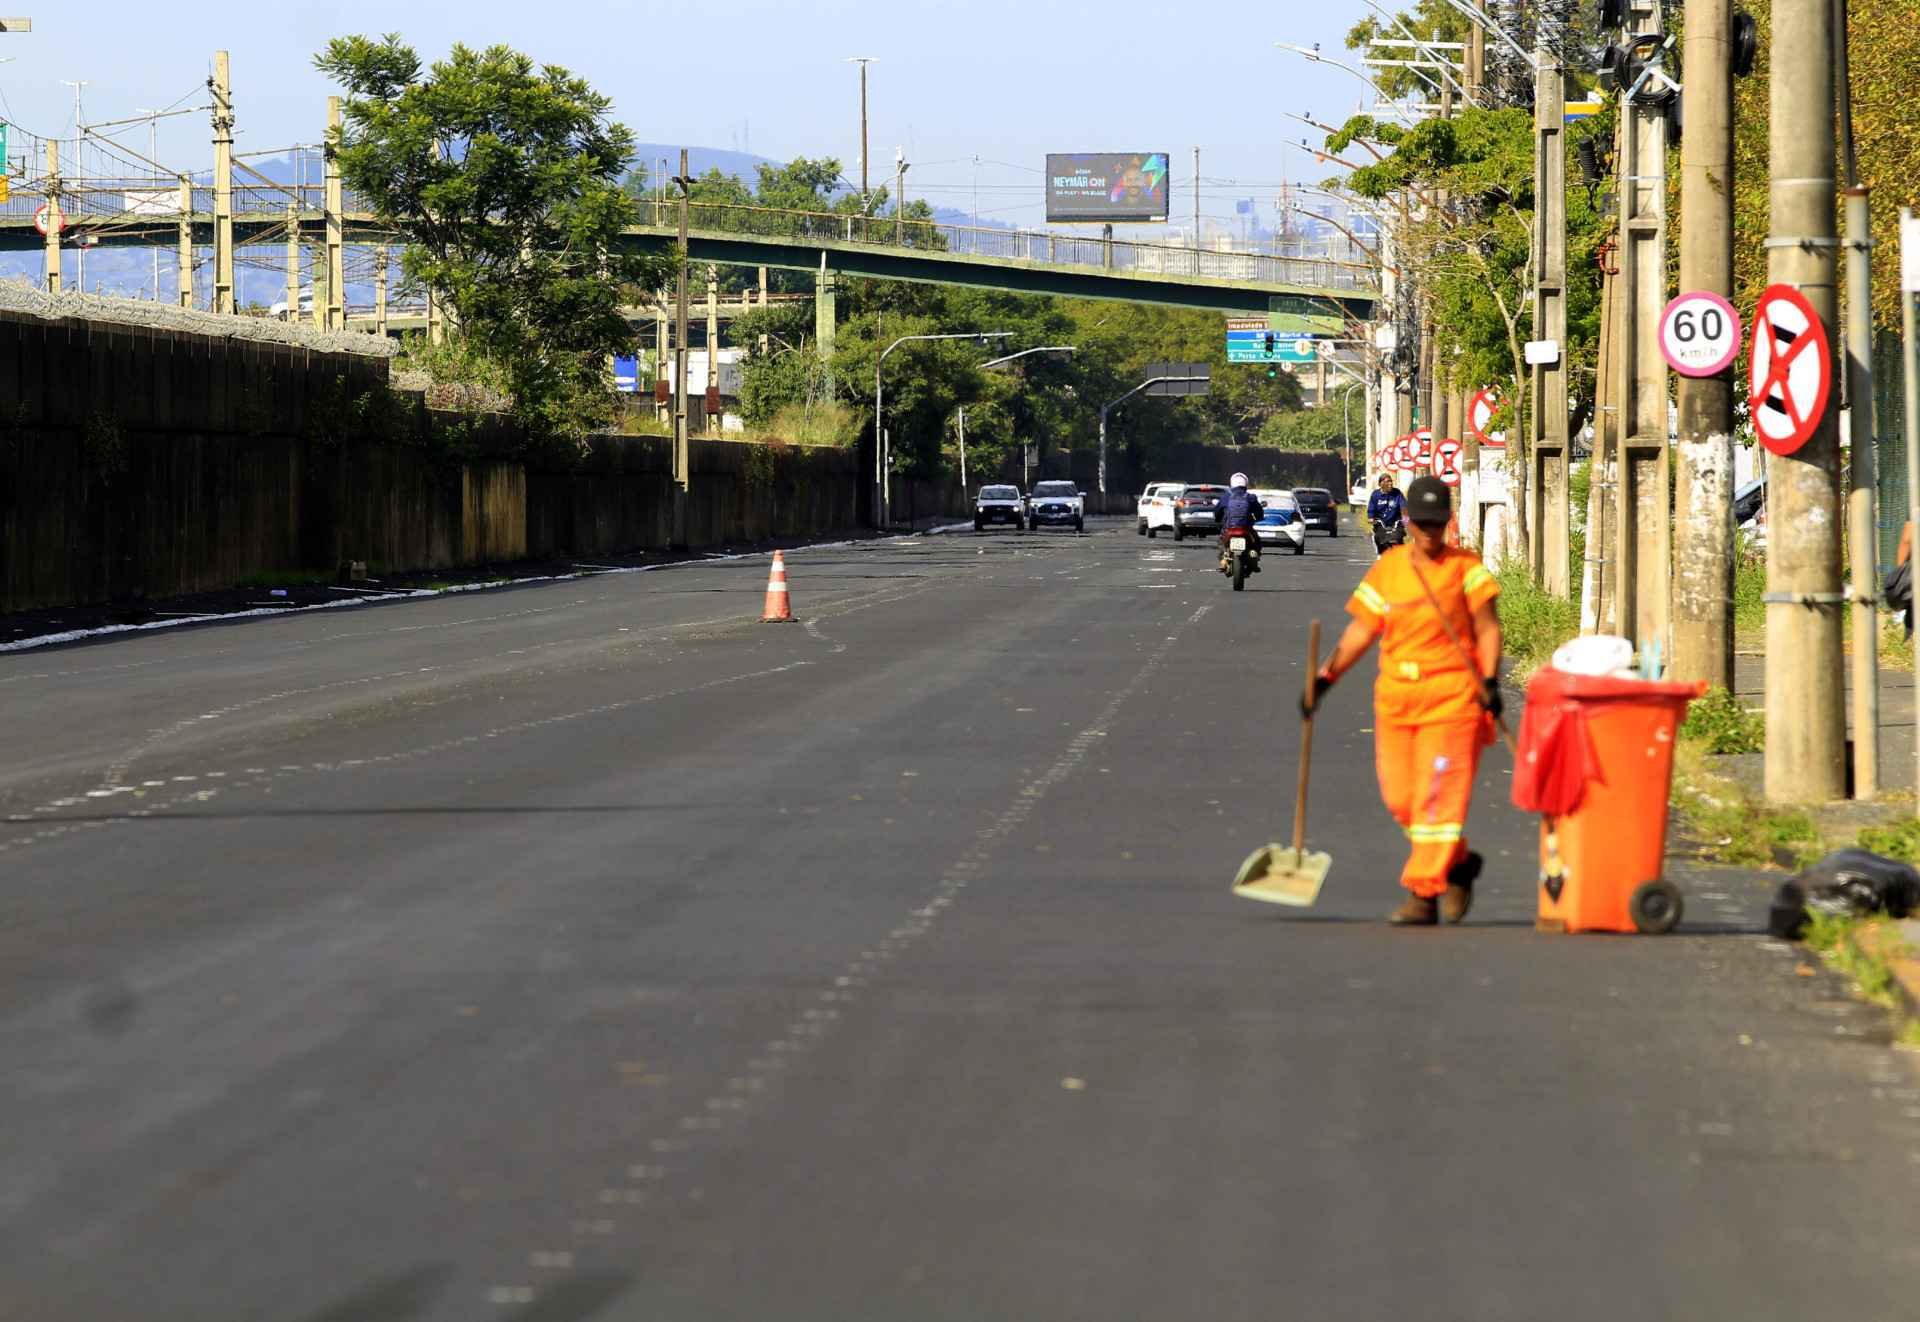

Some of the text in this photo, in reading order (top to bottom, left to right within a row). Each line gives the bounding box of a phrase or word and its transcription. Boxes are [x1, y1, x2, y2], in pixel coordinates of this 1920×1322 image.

[1054, 175, 1105, 188] NEYMAR ON
[1674, 308, 1722, 342] 60
[1680, 347, 1718, 358] km/h
